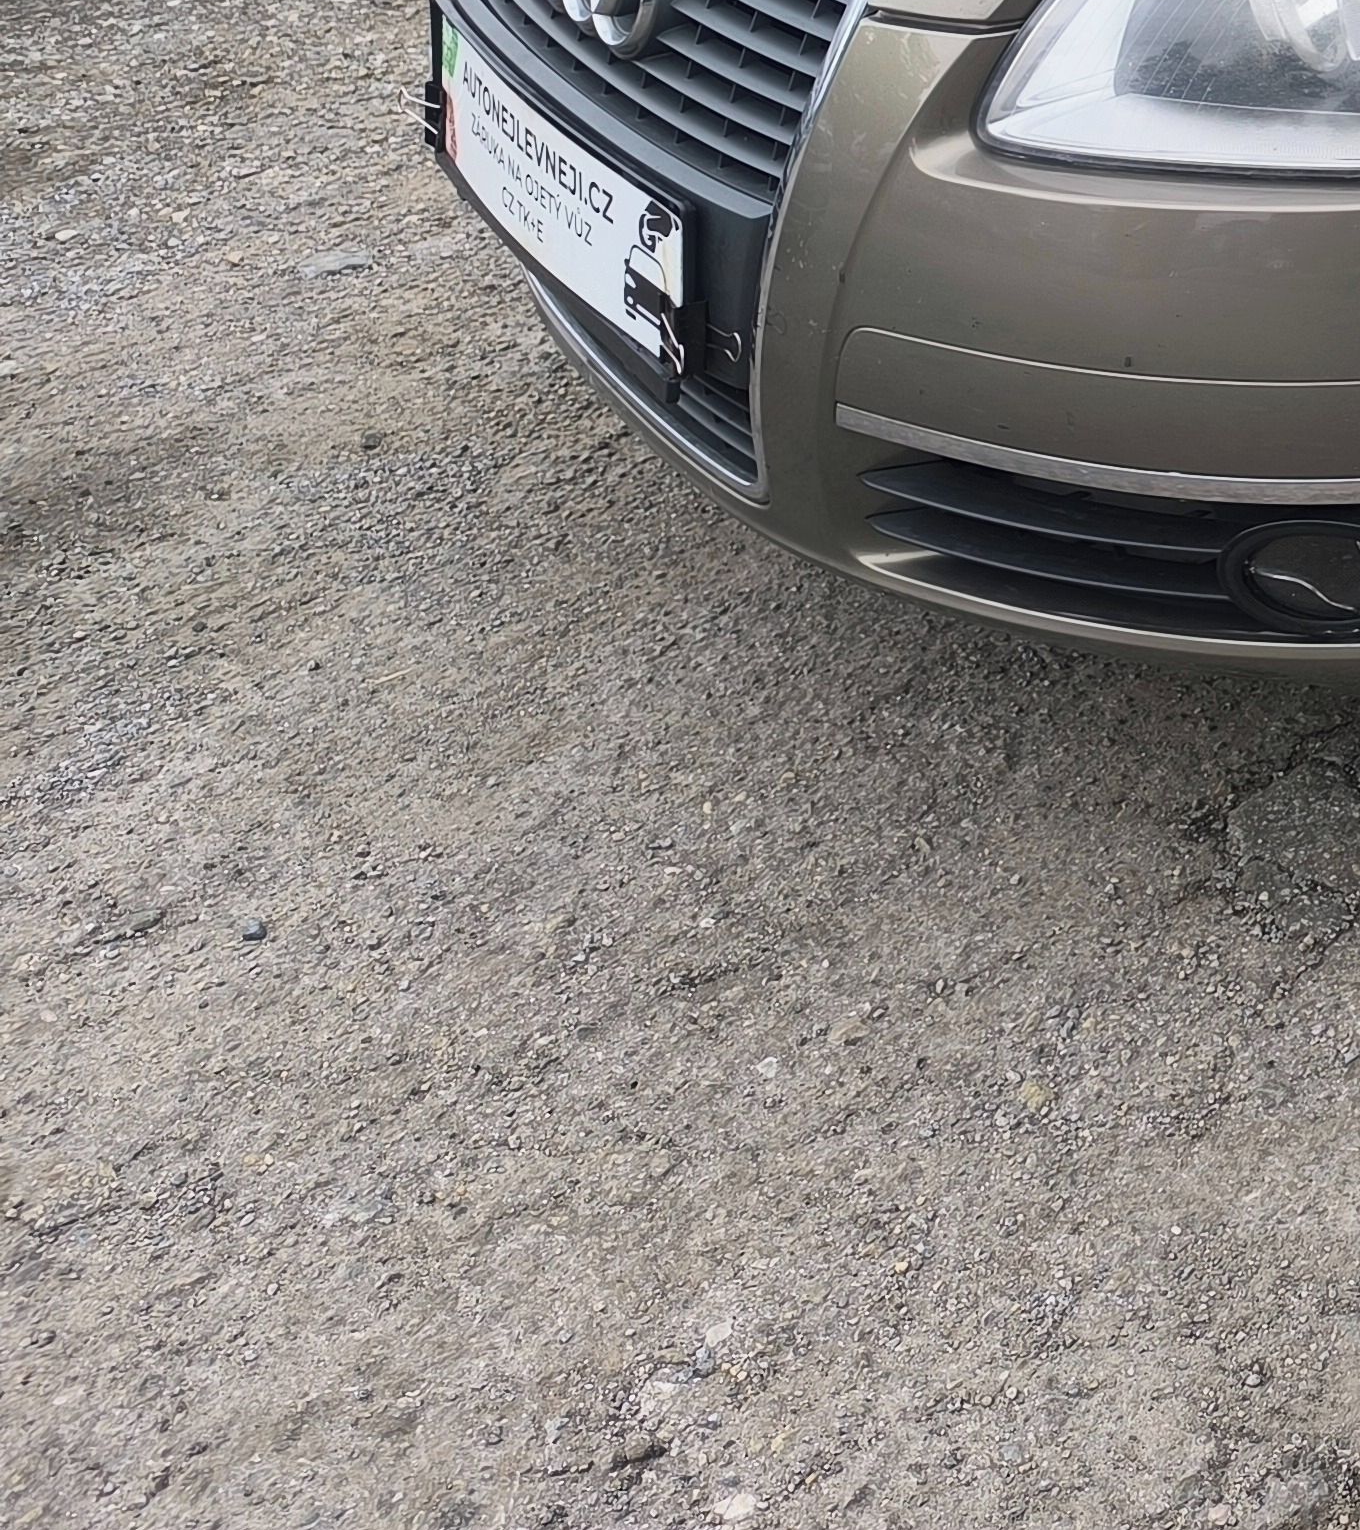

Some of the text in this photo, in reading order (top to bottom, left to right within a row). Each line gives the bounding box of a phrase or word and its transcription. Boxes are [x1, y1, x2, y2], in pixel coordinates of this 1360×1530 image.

[462, 61, 614, 225] AUTONEJLEVNEJI.CZ
[470, 112, 506, 171] ZÁRUKA
[507, 154, 523, 190] NA
[525, 173, 562, 220] OJETÝ
[564, 207, 593, 247] VŮZ
